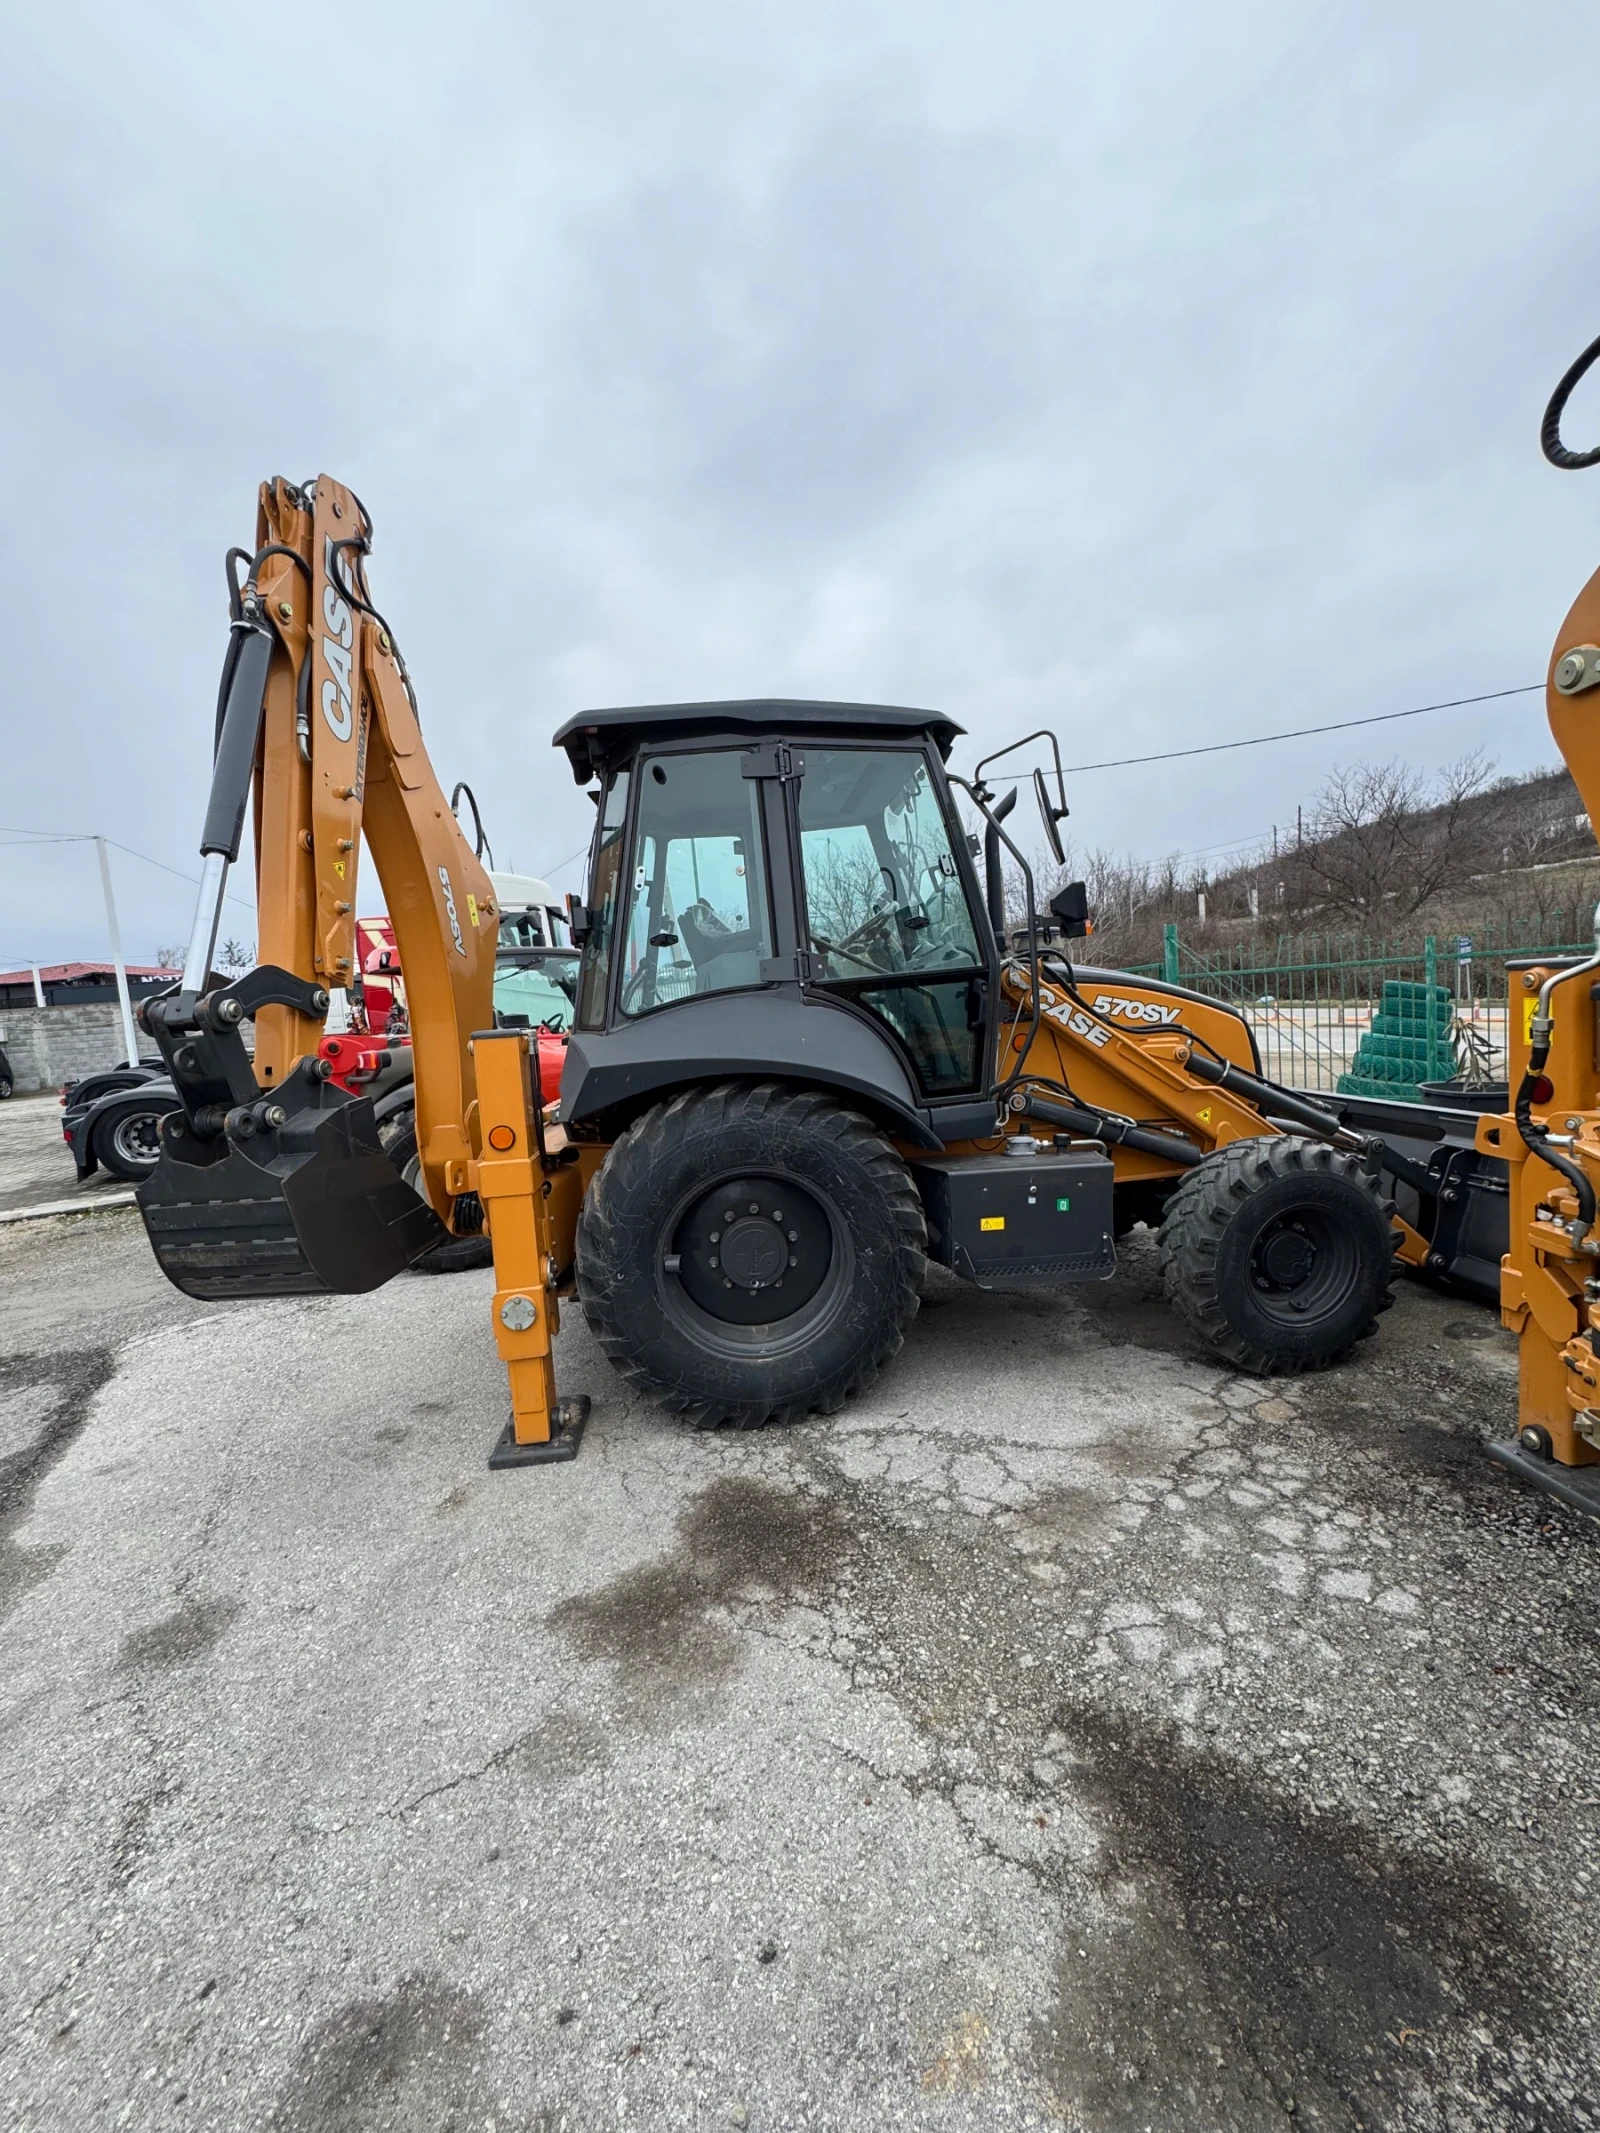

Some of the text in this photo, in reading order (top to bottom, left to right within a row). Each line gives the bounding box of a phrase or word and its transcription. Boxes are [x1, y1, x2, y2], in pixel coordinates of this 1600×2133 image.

[321, 530, 354, 743] CASE
[438, 865, 467, 959] 570SV
[1030, 987, 1113, 1048] CASE
[1092, 994, 1183, 1024] 570SV
